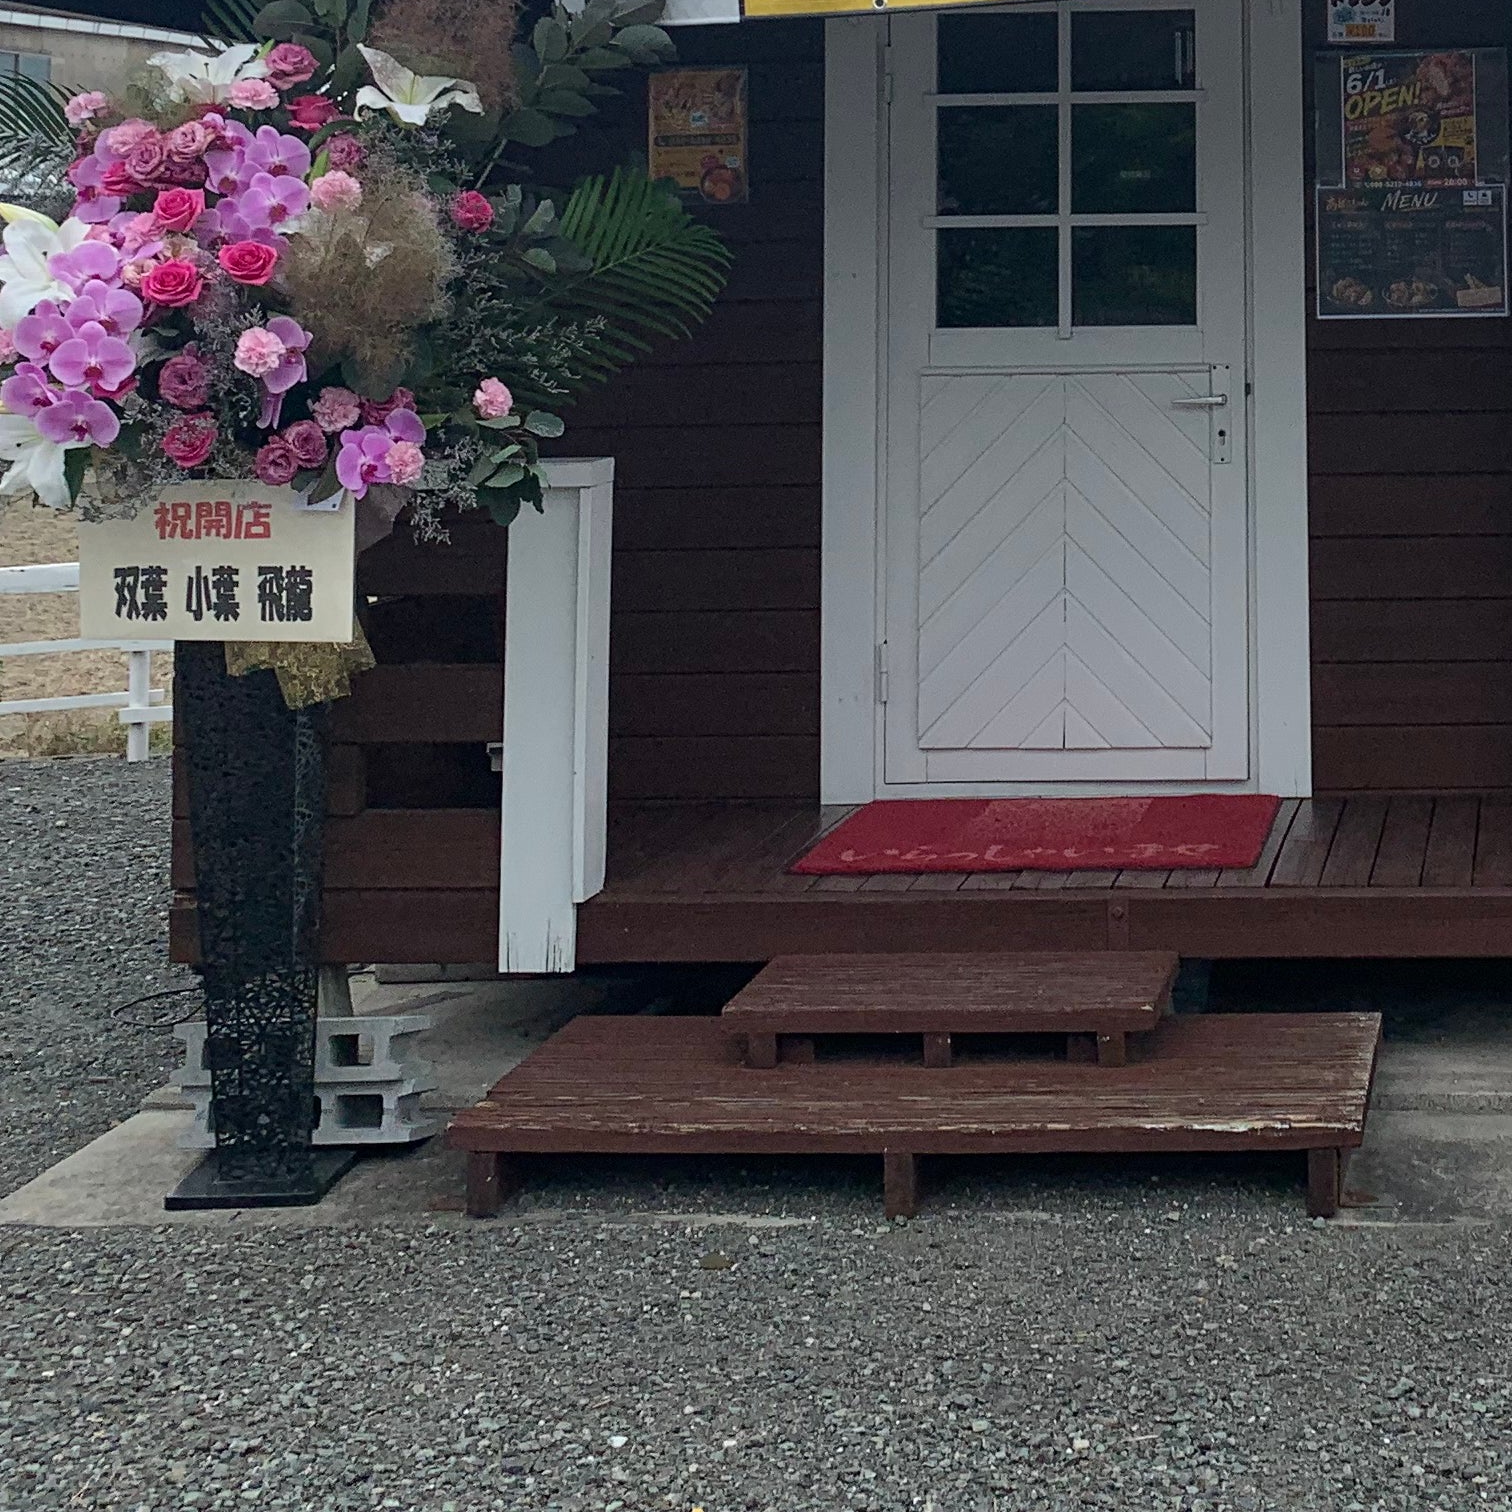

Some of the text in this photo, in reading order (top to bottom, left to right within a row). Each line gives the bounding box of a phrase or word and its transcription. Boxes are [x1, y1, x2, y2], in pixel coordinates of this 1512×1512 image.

[1344, 81, 1421, 120] OPEN!
[1346, 69, 1386, 94] 6/1
[1380, 190, 1439, 211] MENU
[154, 501, 272, 540] 祝開店
[113, 565, 313, 621] 双葉 小葉 飛龍
